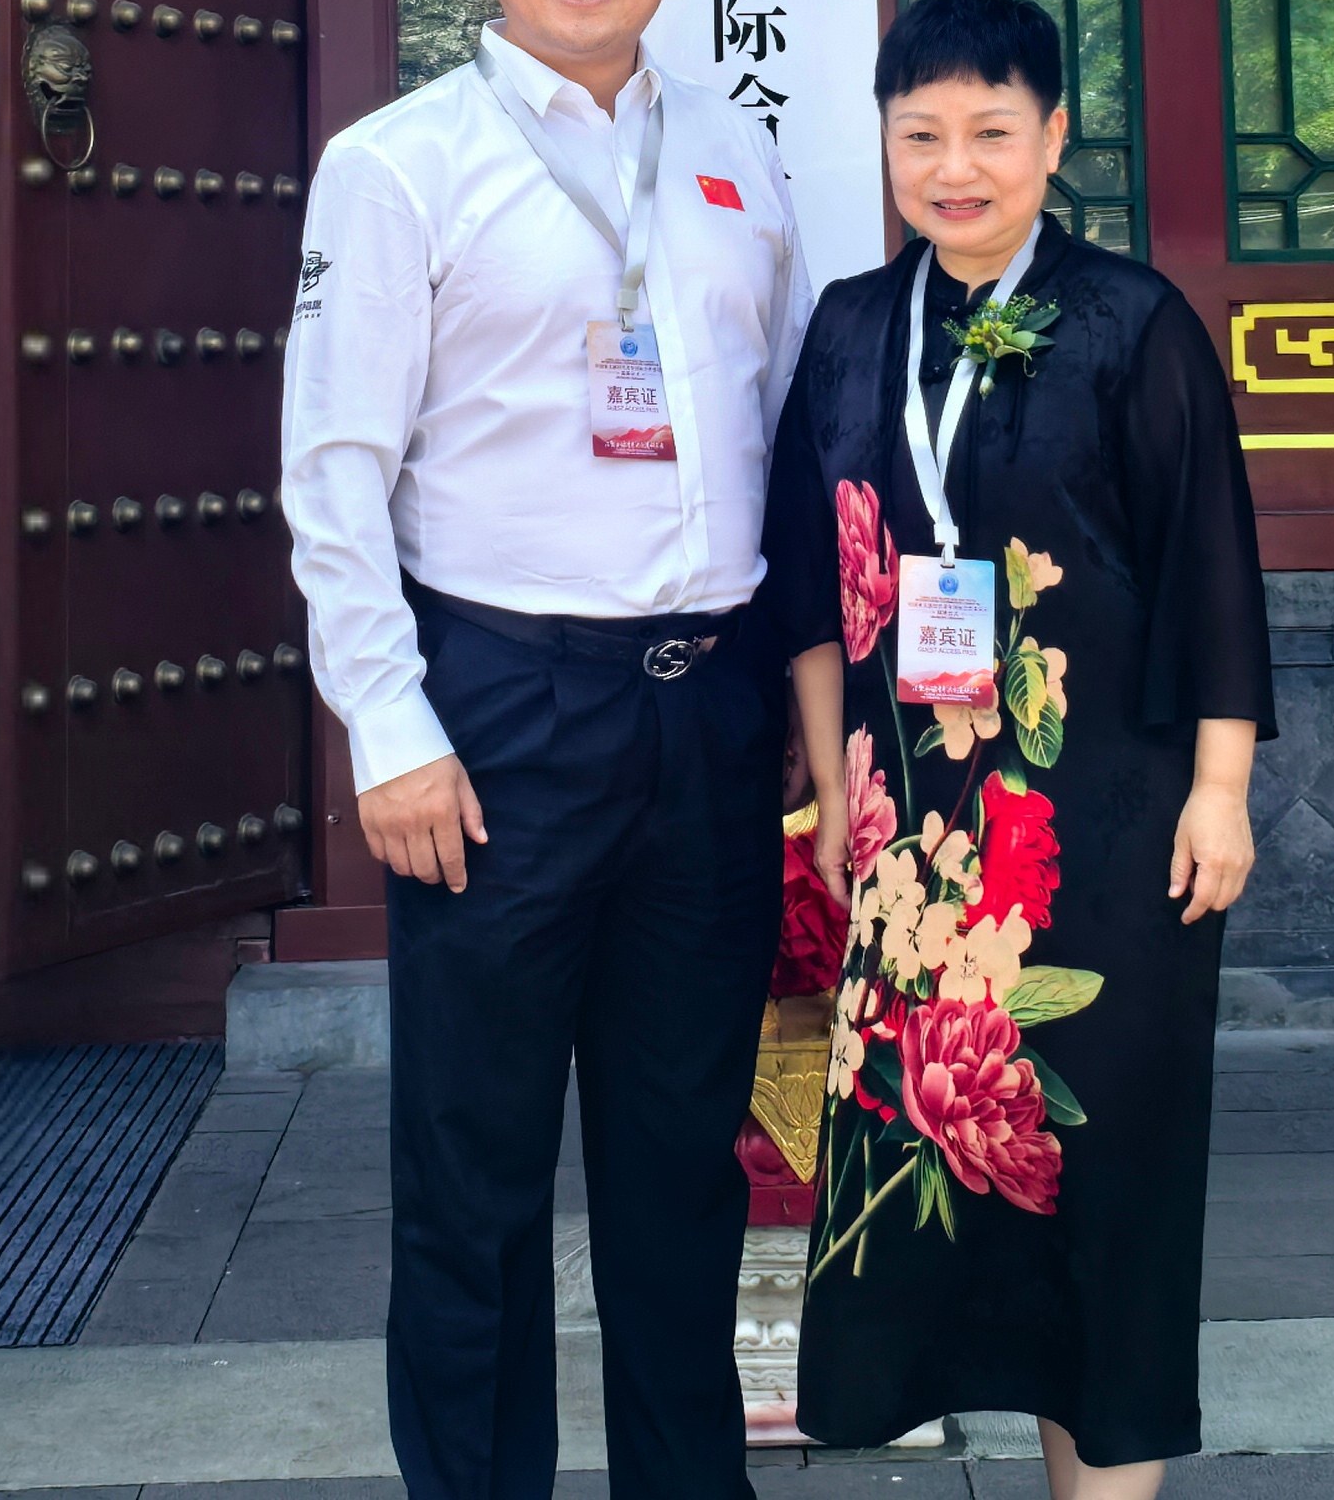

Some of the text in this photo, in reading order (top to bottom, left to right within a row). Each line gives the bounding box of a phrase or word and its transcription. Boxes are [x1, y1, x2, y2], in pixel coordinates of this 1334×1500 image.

[607, 385, 658, 405] 嘉宾证
[919, 625, 977, 647] 嘉宾证
